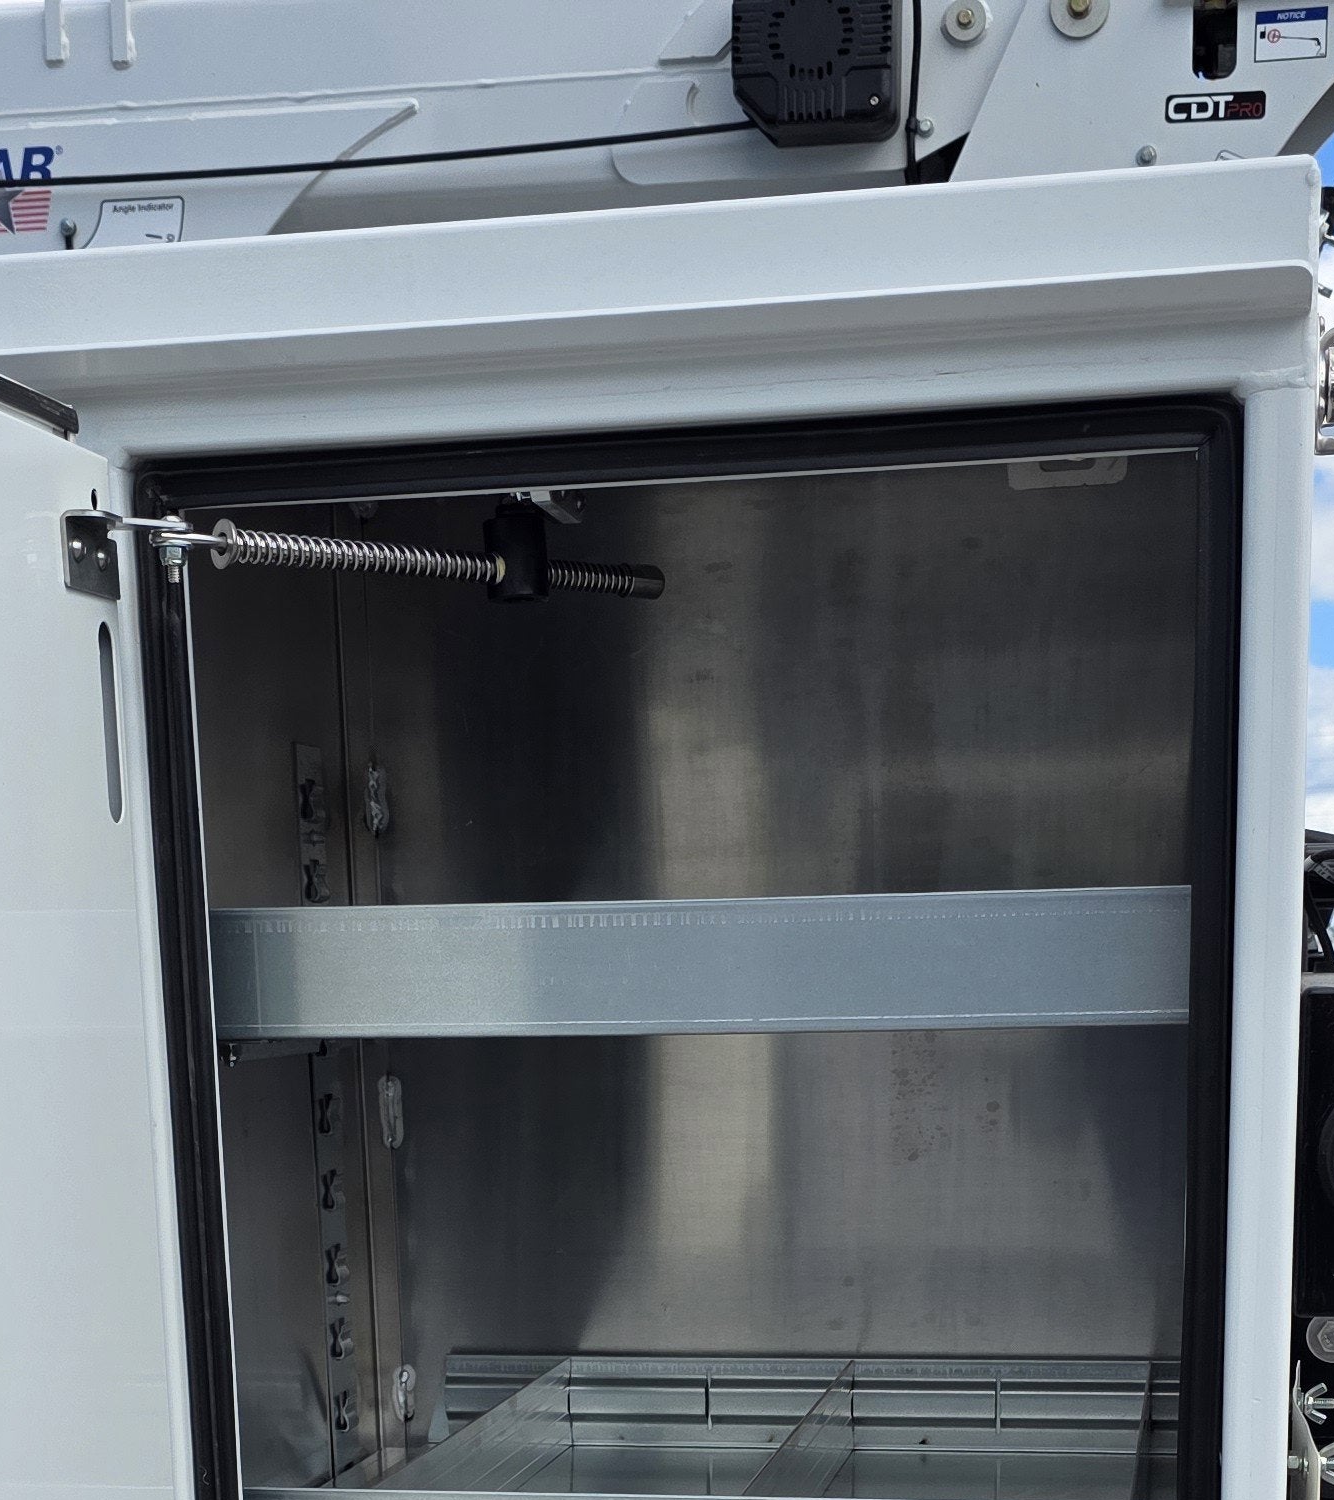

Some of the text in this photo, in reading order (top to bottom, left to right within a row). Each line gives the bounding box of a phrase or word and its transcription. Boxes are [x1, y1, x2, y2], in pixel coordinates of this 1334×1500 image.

[1277, 11, 1307, 20] NOTICE
[1168, 95, 1262, 120] CDT PRO
[112, 203, 174, 215] Angle Indicator
